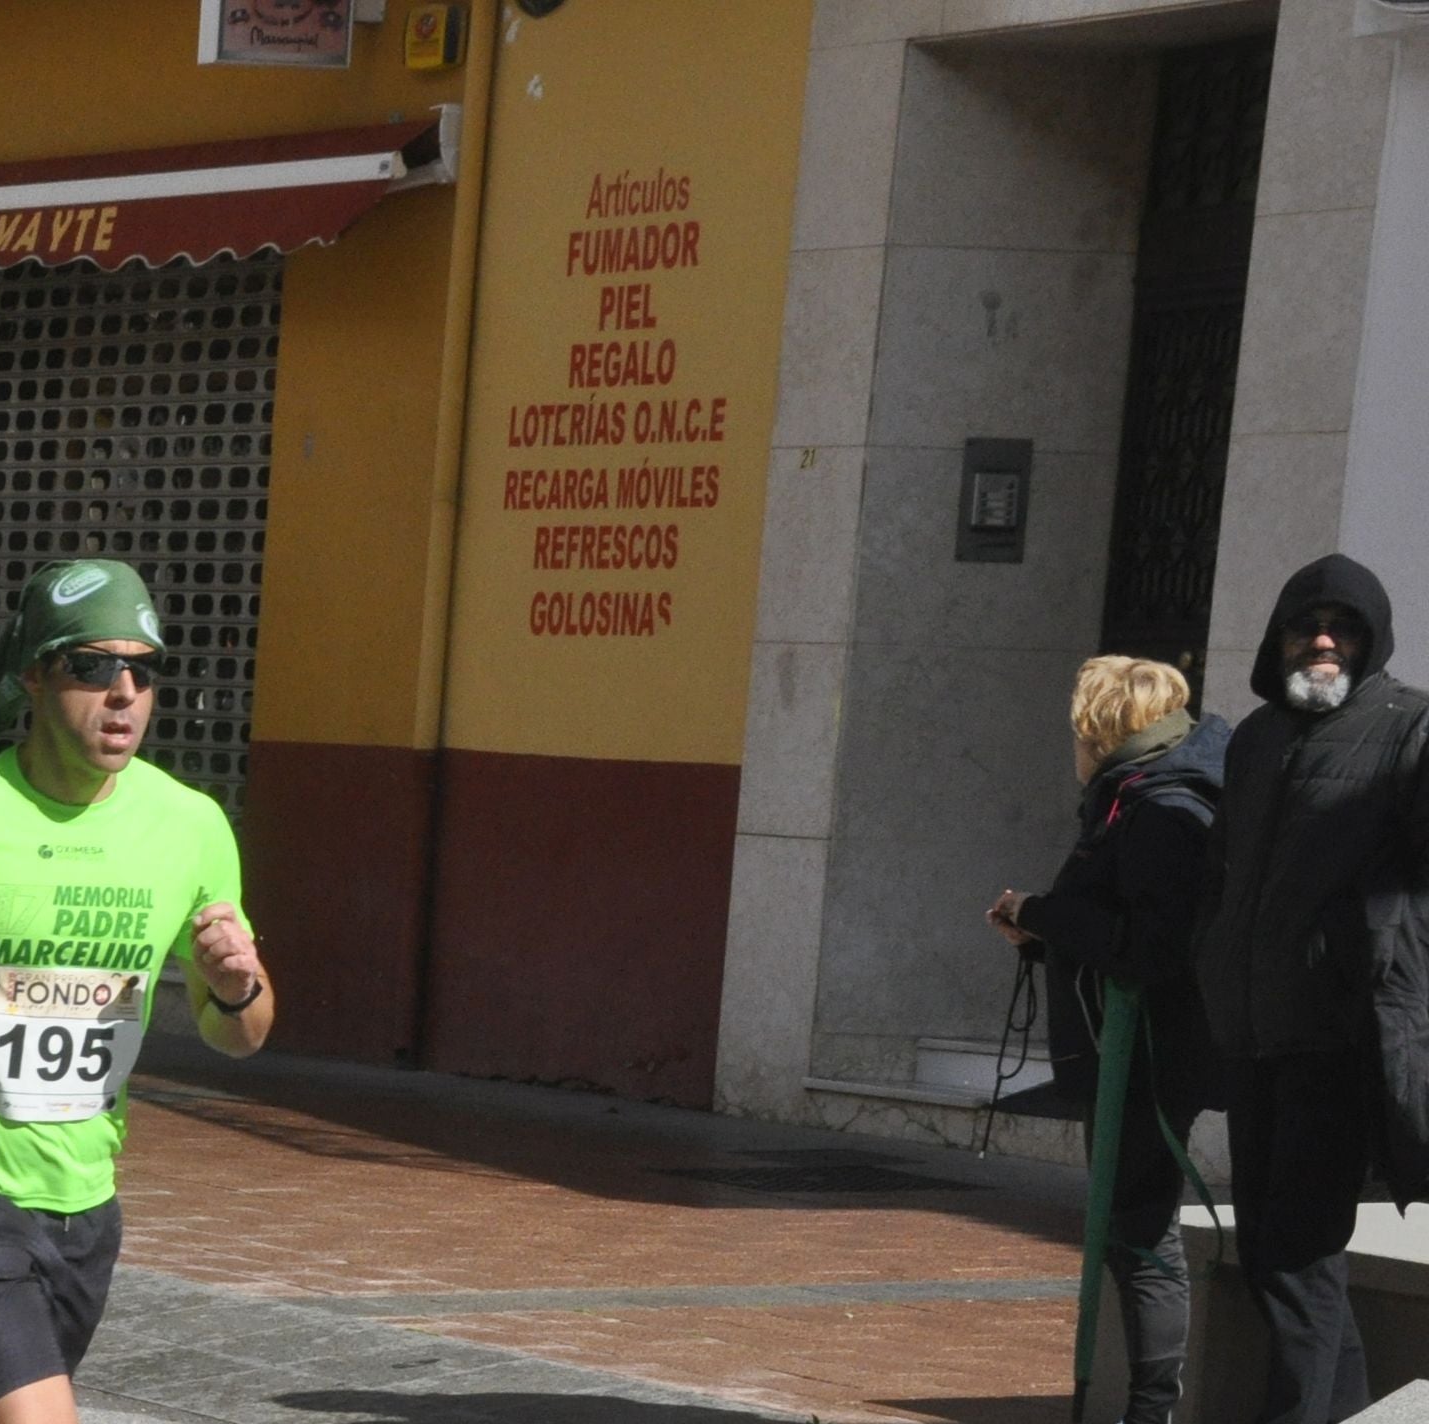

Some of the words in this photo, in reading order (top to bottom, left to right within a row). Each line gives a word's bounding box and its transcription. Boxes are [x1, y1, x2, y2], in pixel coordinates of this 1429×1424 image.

[586, 168, 690, 218] Artículos
[566, 221, 700, 277] FUMADOR
[598, 284, 657, 331] PIEL
[569, 339, 676, 388] REGALO
[504, 469, 609, 510] RECARGA
[616, 458, 720, 508] MÓVILES
[533, 524, 678, 569] REFRESCOS
[531, 591, 672, 636] GOLOSINAS
[56, 845, 105, 855] OXIMESA
[53, 885, 154, 909] MEMORIAL
[52, 909, 149, 939] PADRE
[13, 981, 111, 1006] FONDO
